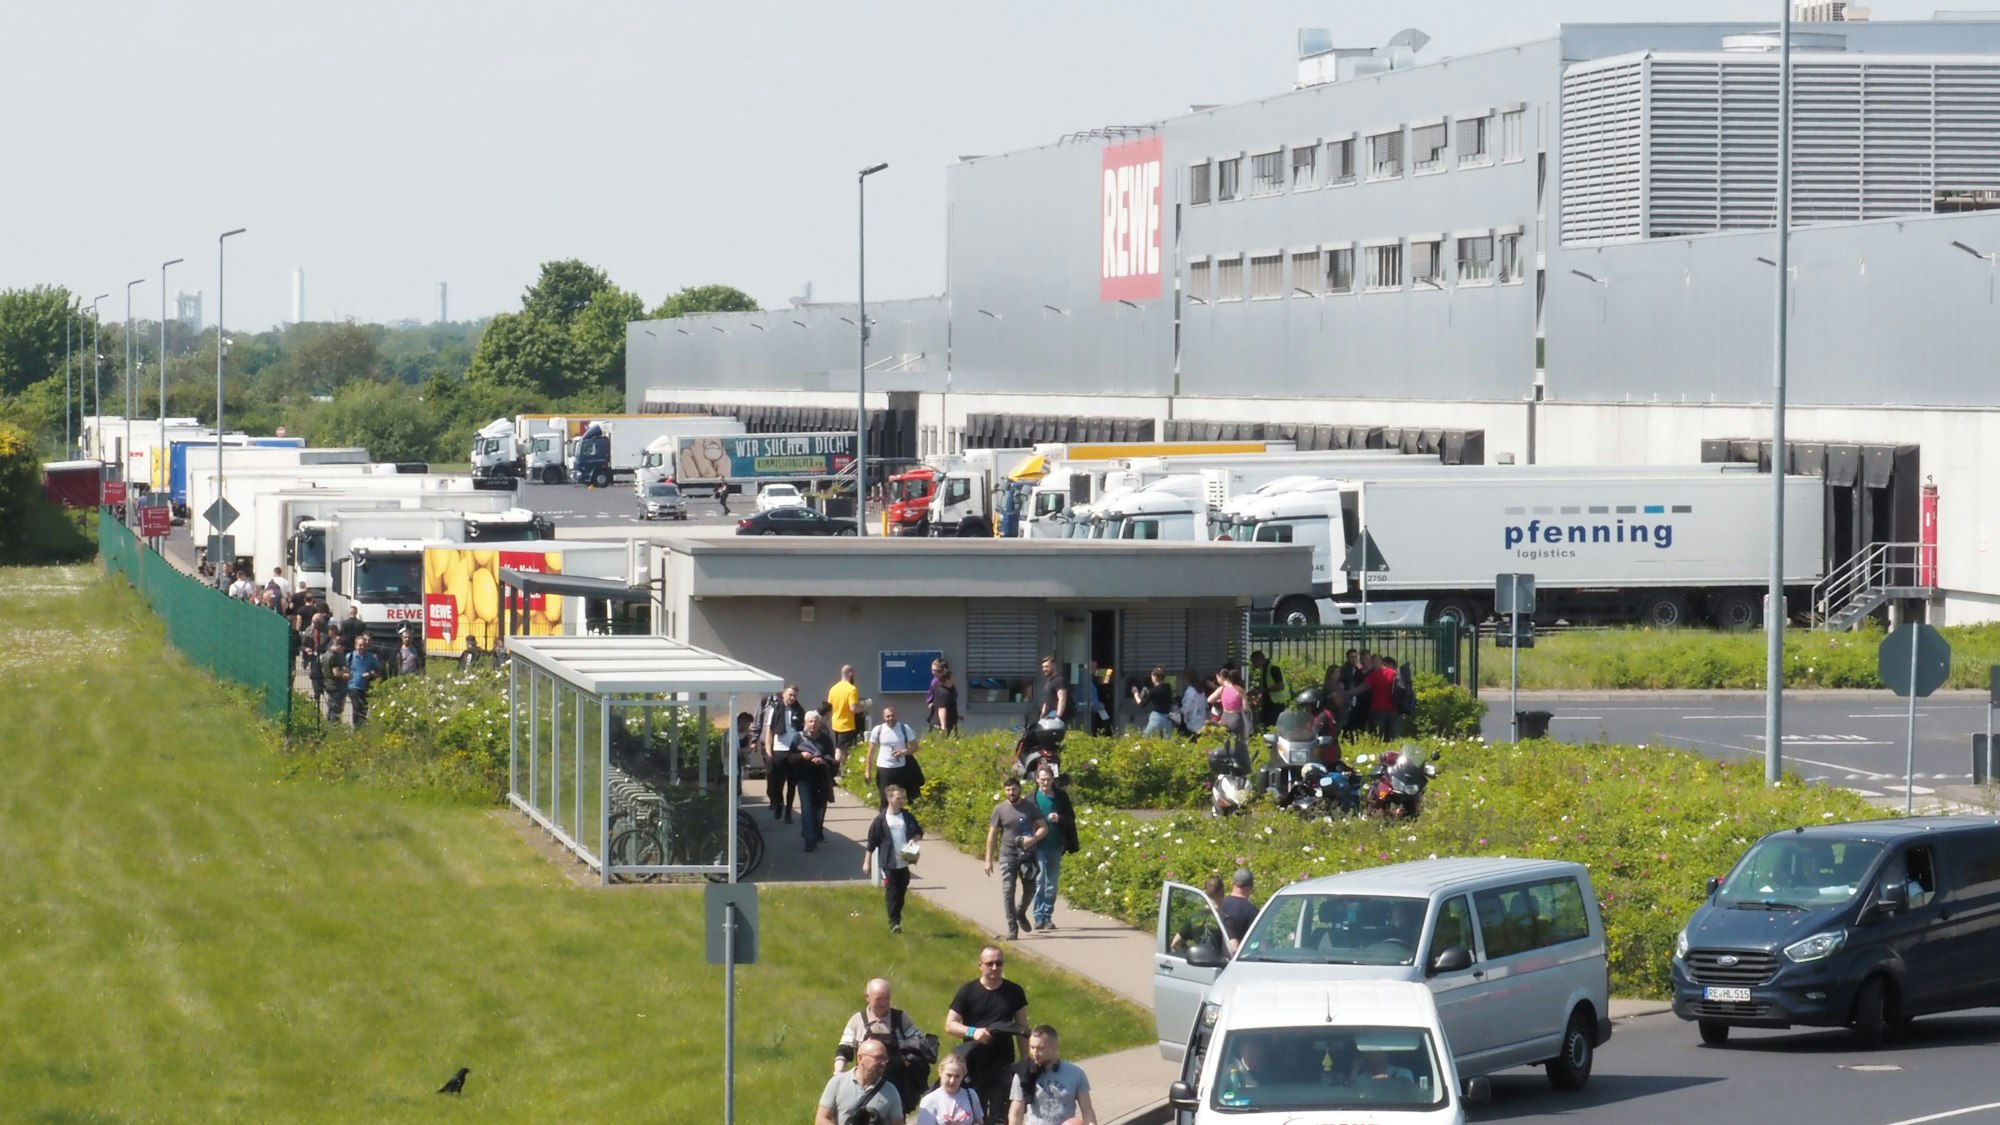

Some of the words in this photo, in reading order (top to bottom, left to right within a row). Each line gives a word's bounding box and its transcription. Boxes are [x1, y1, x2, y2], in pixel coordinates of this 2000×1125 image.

[1103, 160, 1160, 278] REWE
[735, 439, 760, 457] WIR
[815, 436, 850, 454] DICH!
[1505, 519, 1672, 550] pfenning
[1517, 549, 1576, 560] logistics
[387, 609, 422, 619] REWE
[430, 604, 452, 619] REWE
[1708, 989, 1719, 998] RE
[1734, 990, 1750, 999] 515
